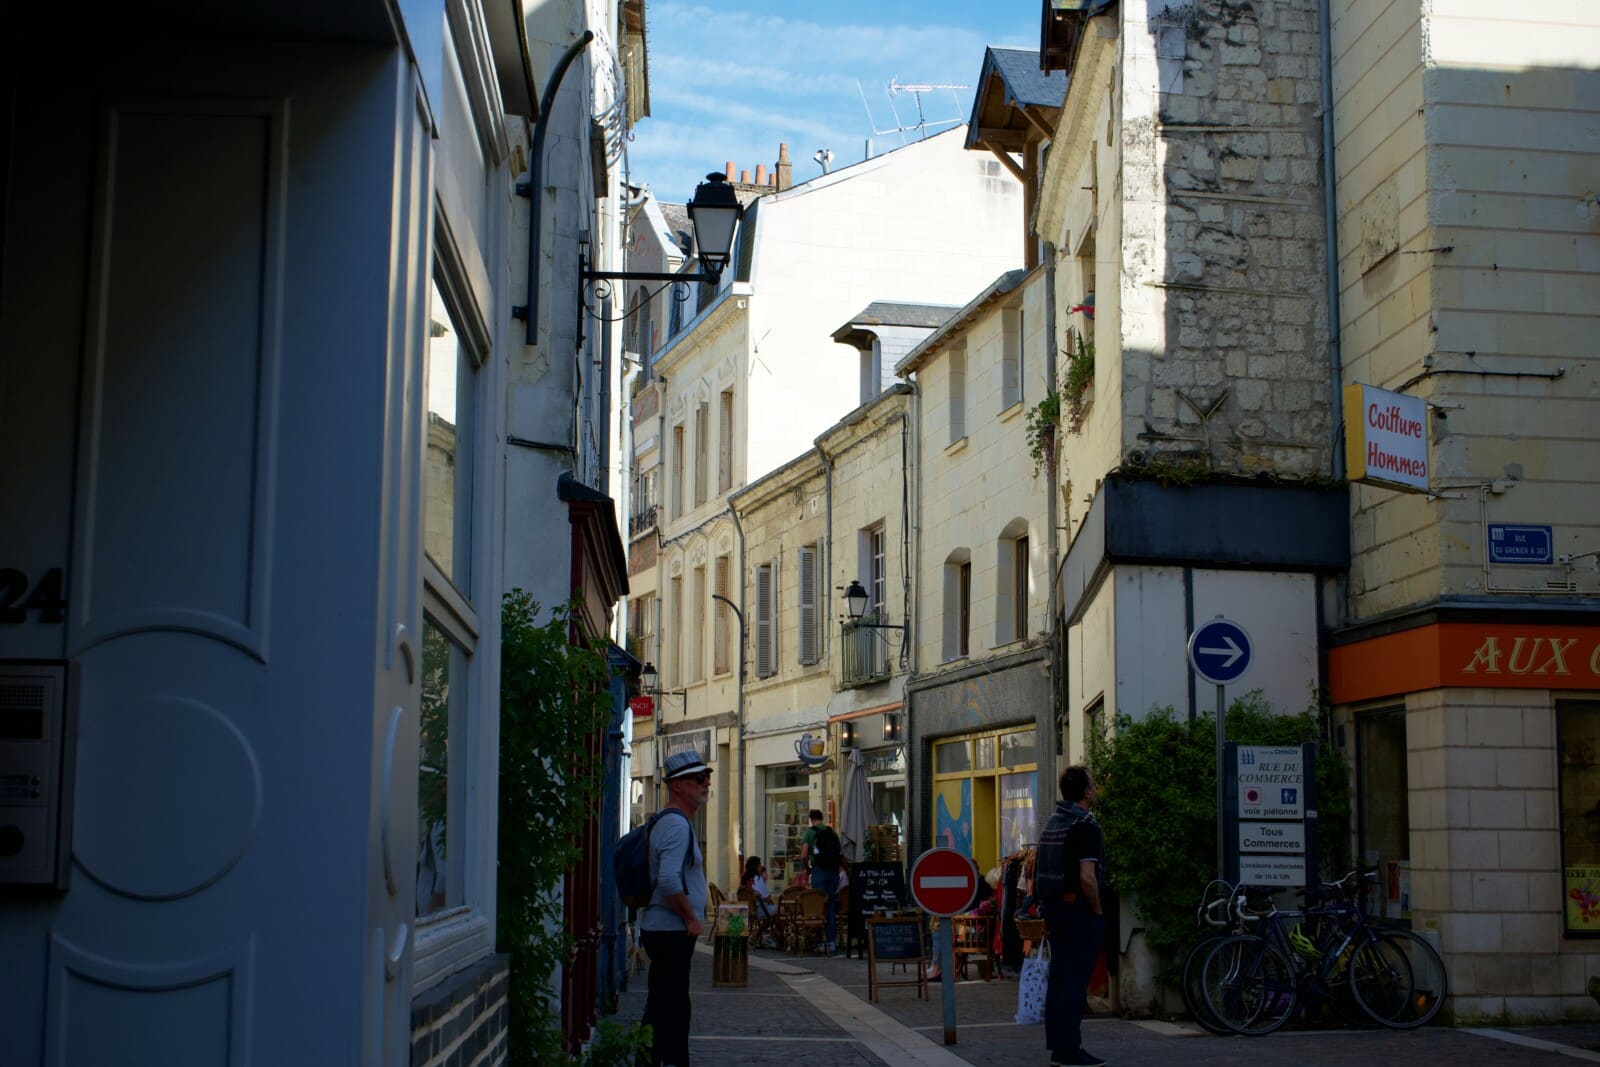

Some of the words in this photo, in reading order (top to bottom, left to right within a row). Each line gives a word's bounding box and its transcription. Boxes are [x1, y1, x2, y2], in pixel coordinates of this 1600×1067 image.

[1368, 403, 1422, 438] Coiffure
[1367, 441, 1427, 477] Hommes
[1514, 535, 1527, 543] RUE
[1504, 546, 1529, 555] GRENIER
[0, 568, 68, 623] 24
[1461, 636, 1580, 676] AUX
[1258, 763, 1282, 772] RUE
[1283, 763, 1299, 772] DU
[1238, 773, 1303, 784] COMMERCE
[1243, 808, 1261, 816] voie
[1263, 806, 1298, 817] piétonne
[1260, 827, 1283, 836] Tous
[1243, 838, 1301, 849] Commerces
